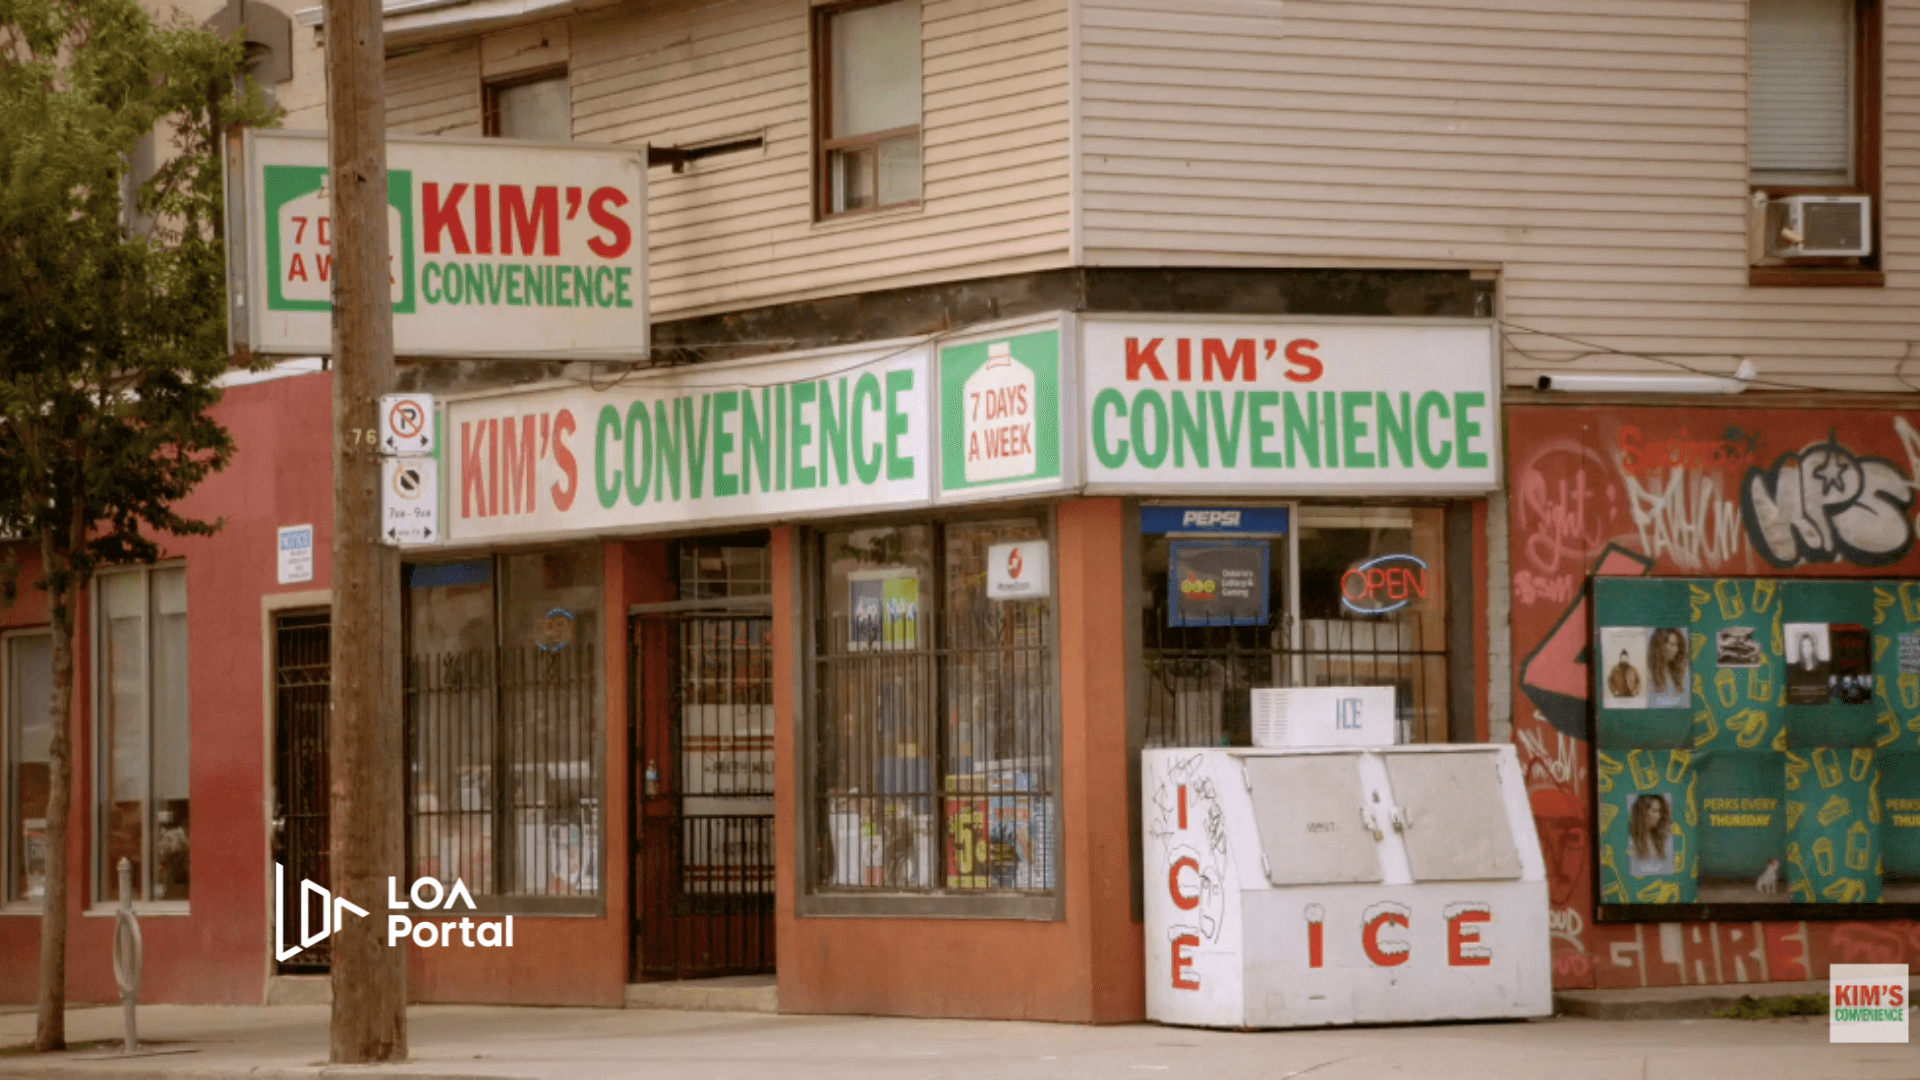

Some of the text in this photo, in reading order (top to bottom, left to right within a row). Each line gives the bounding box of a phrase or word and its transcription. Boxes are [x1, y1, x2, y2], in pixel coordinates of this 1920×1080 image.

[292, 217, 307, 245] 7
[422, 182, 632, 259] KIM'S
[288, 253, 308, 282] A
[421, 261, 633, 308] CONVENIENCE
[1125, 337, 1324, 382] KIM'S
[969, 383, 1029, 421] 7 DAYS
[461, 369, 915, 519] KIM'S CONVENIENCE
[968, 422, 1032, 462] A WEEK
[1091, 387, 1489, 469] CONVENIENCE
[1182, 510, 1242, 527] PEPSI
[1341, 567, 1427, 600] OPEN
[1336, 698, 1363, 729] ICE
[1304, 902, 1493, 968] ICE
